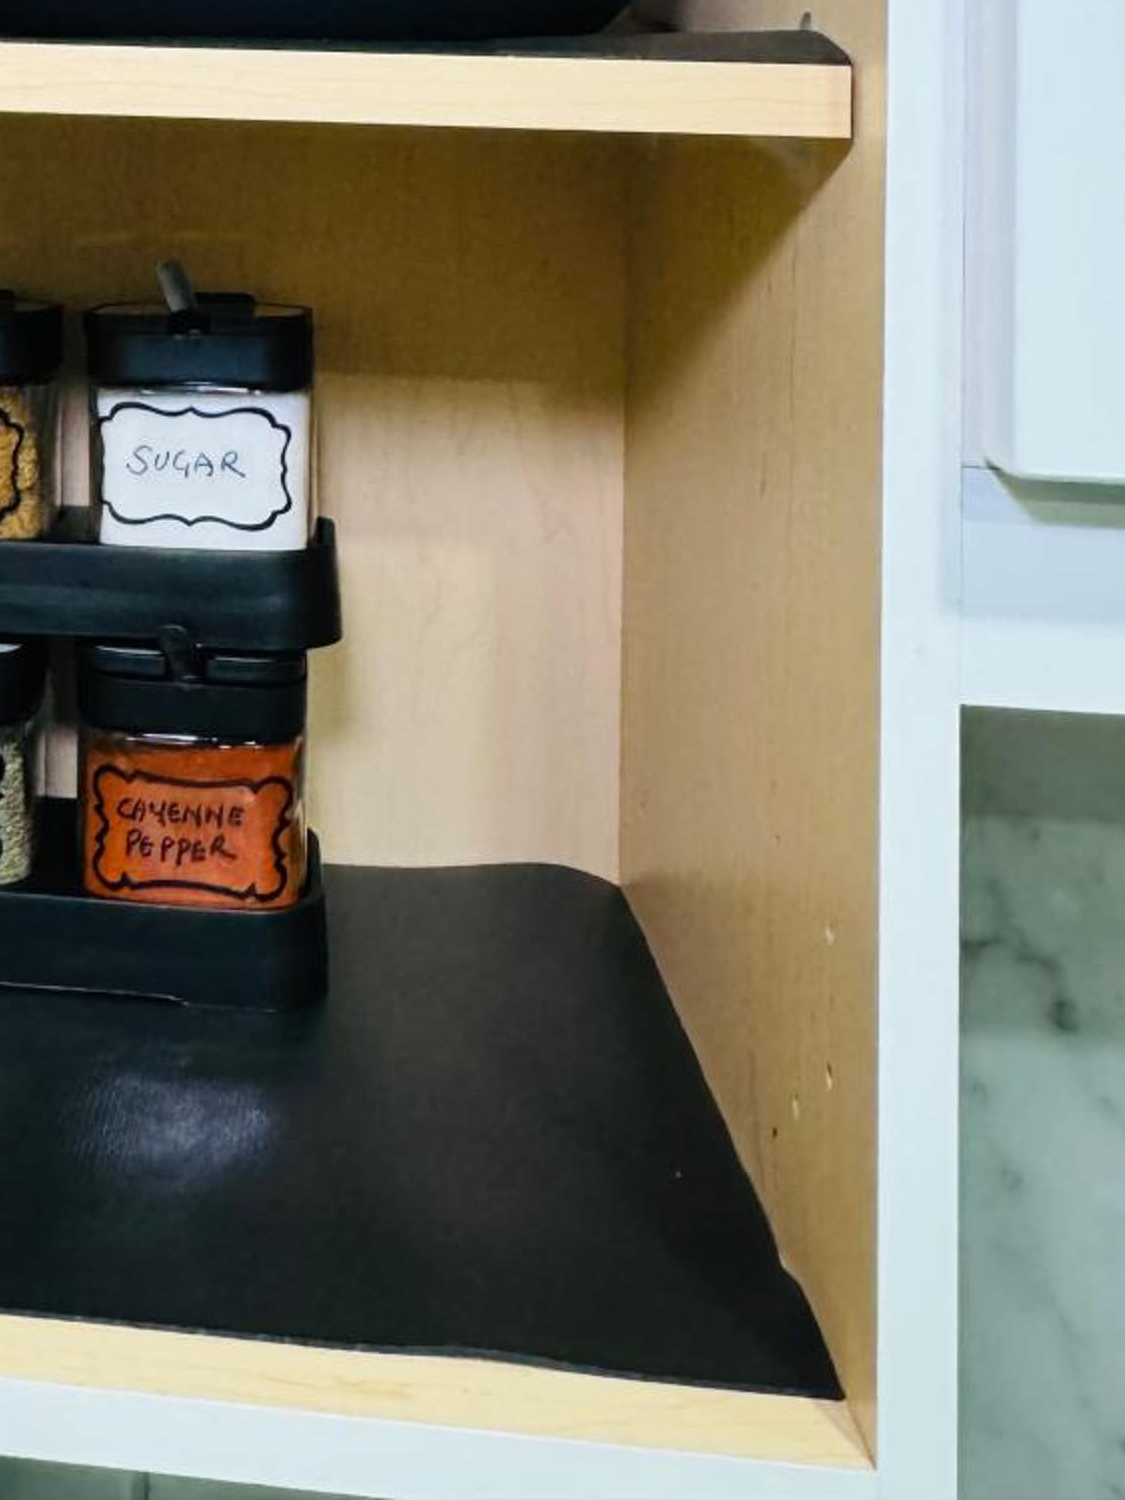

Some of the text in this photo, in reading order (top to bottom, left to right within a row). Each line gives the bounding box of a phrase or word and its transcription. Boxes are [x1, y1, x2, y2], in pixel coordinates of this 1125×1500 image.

[126, 444, 246, 479] SUGAR
[116, 797, 245, 829] CAYENNE
[125, 828, 237, 867] PEPPER
